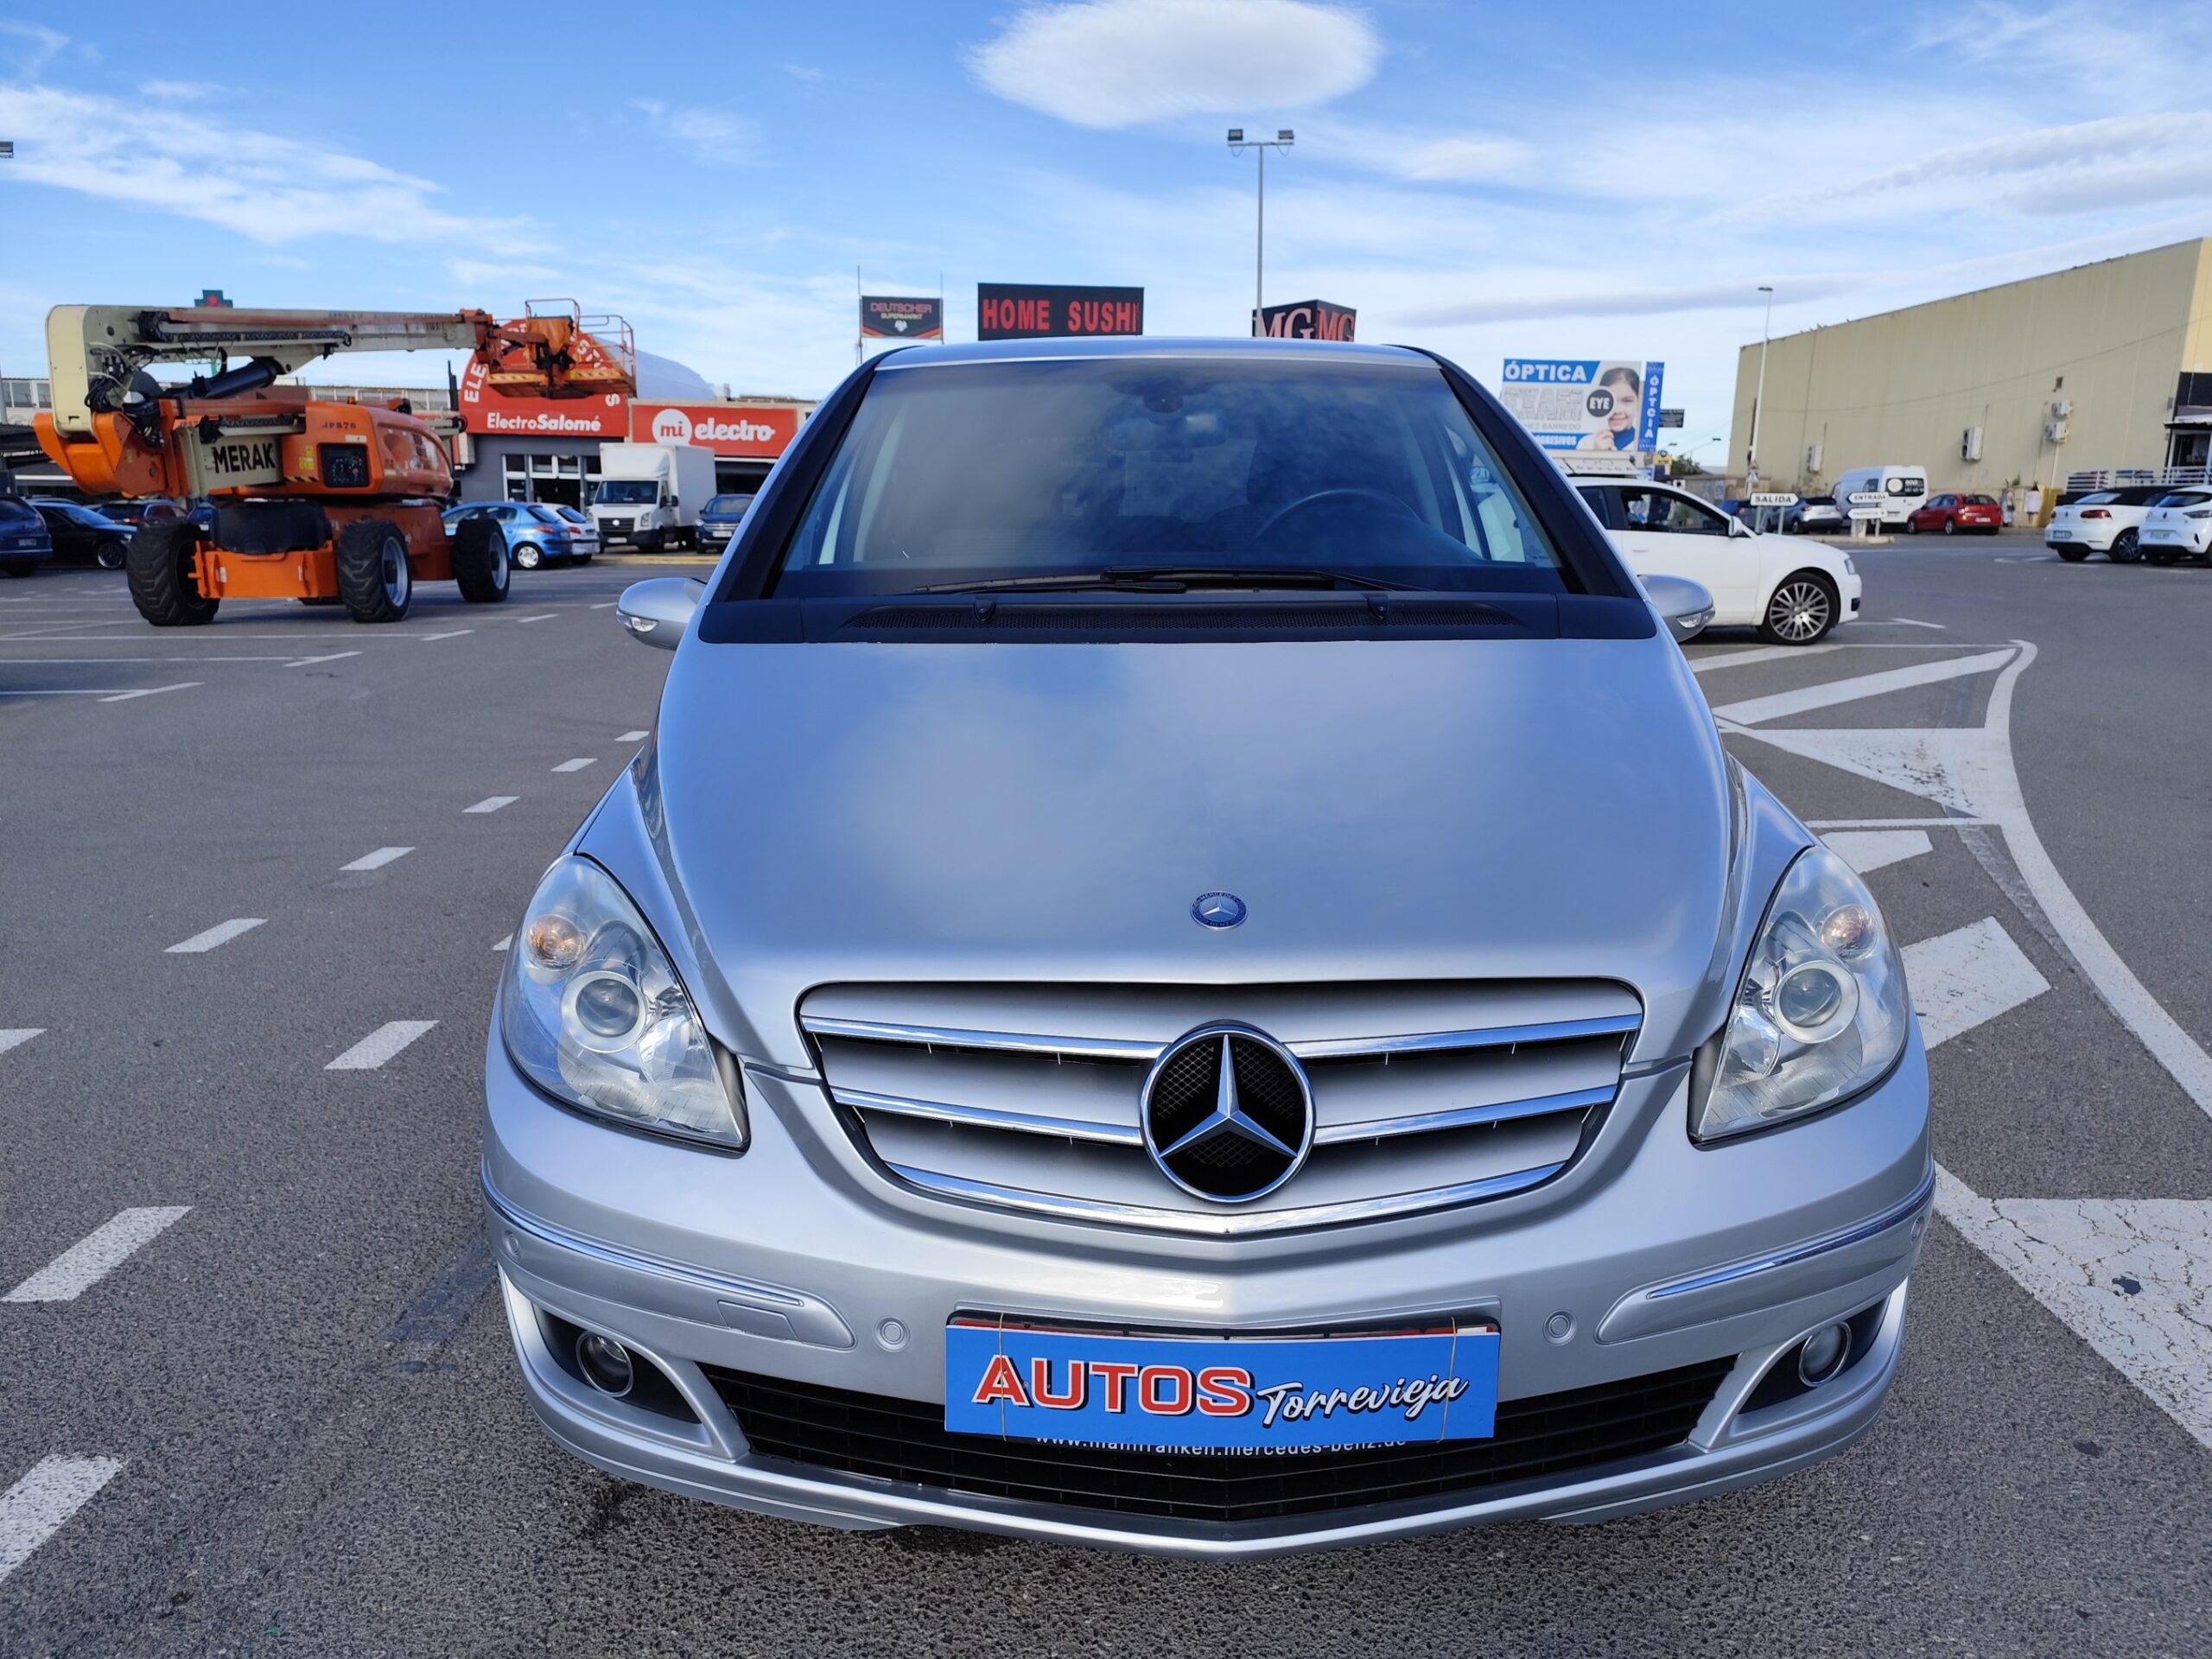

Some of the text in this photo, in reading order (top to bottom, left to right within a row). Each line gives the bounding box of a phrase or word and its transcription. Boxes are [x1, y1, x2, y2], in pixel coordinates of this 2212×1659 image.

[870, 302, 931, 313] DEUTSCHER
[982, 298, 1139, 333] HOME SUSHI
[1504, 360, 1587, 382] ÓPTICA
[1589, 397, 1611, 410] EYE
[486, 412, 601, 432] ElectroSalomé
[660, 417, 776, 442] mi electro
[213, 442, 276, 474] MERAK
[971, 1354, 1469, 1426] AUTOS Torrevieja
